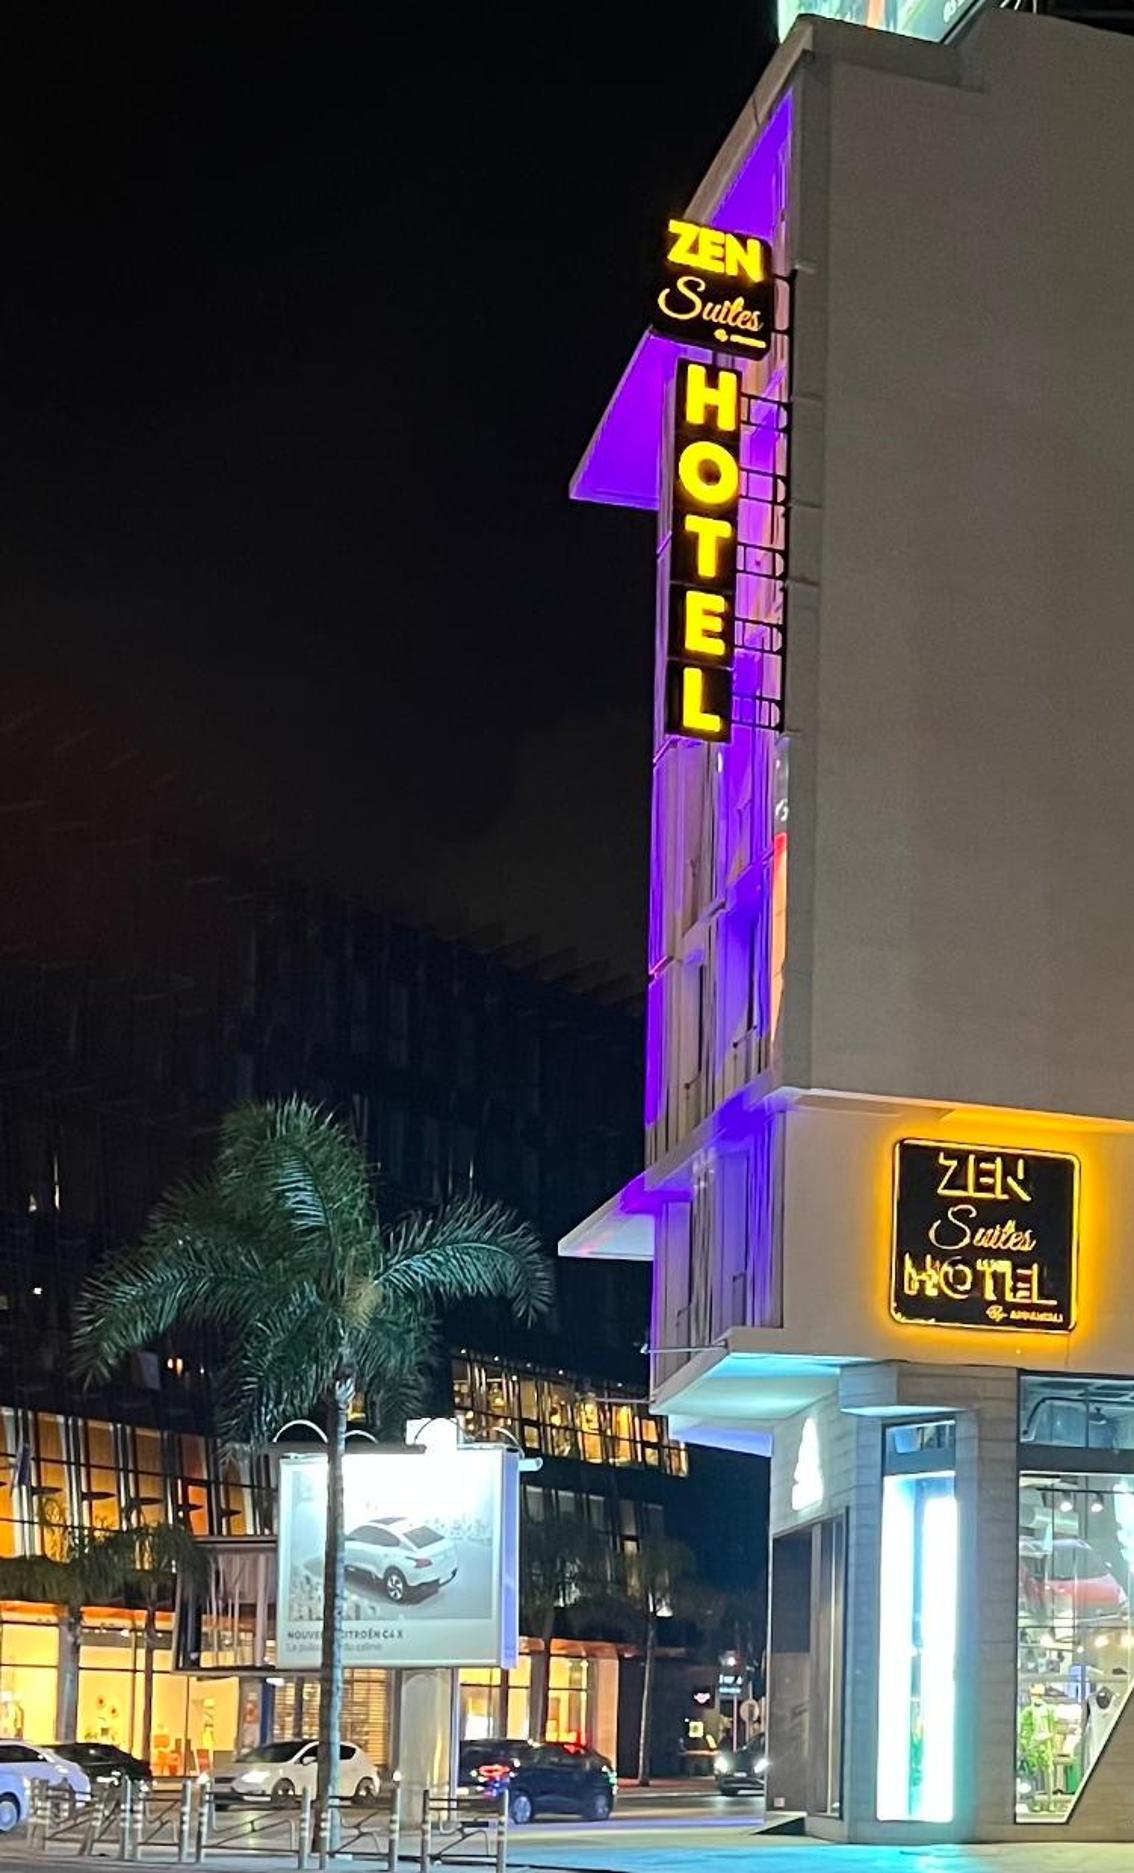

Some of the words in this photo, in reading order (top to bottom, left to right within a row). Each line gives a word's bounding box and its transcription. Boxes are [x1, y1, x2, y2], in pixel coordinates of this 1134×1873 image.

[667, 219, 764, 282] ZEN
[657, 276, 764, 331] Suites
[678, 364, 740, 733] HOTEL
[937, 1151, 1032, 1202] ZEN
[928, 1204, 1036, 1251] Suites
[904, 1252, 1058, 1306] HOTEL
